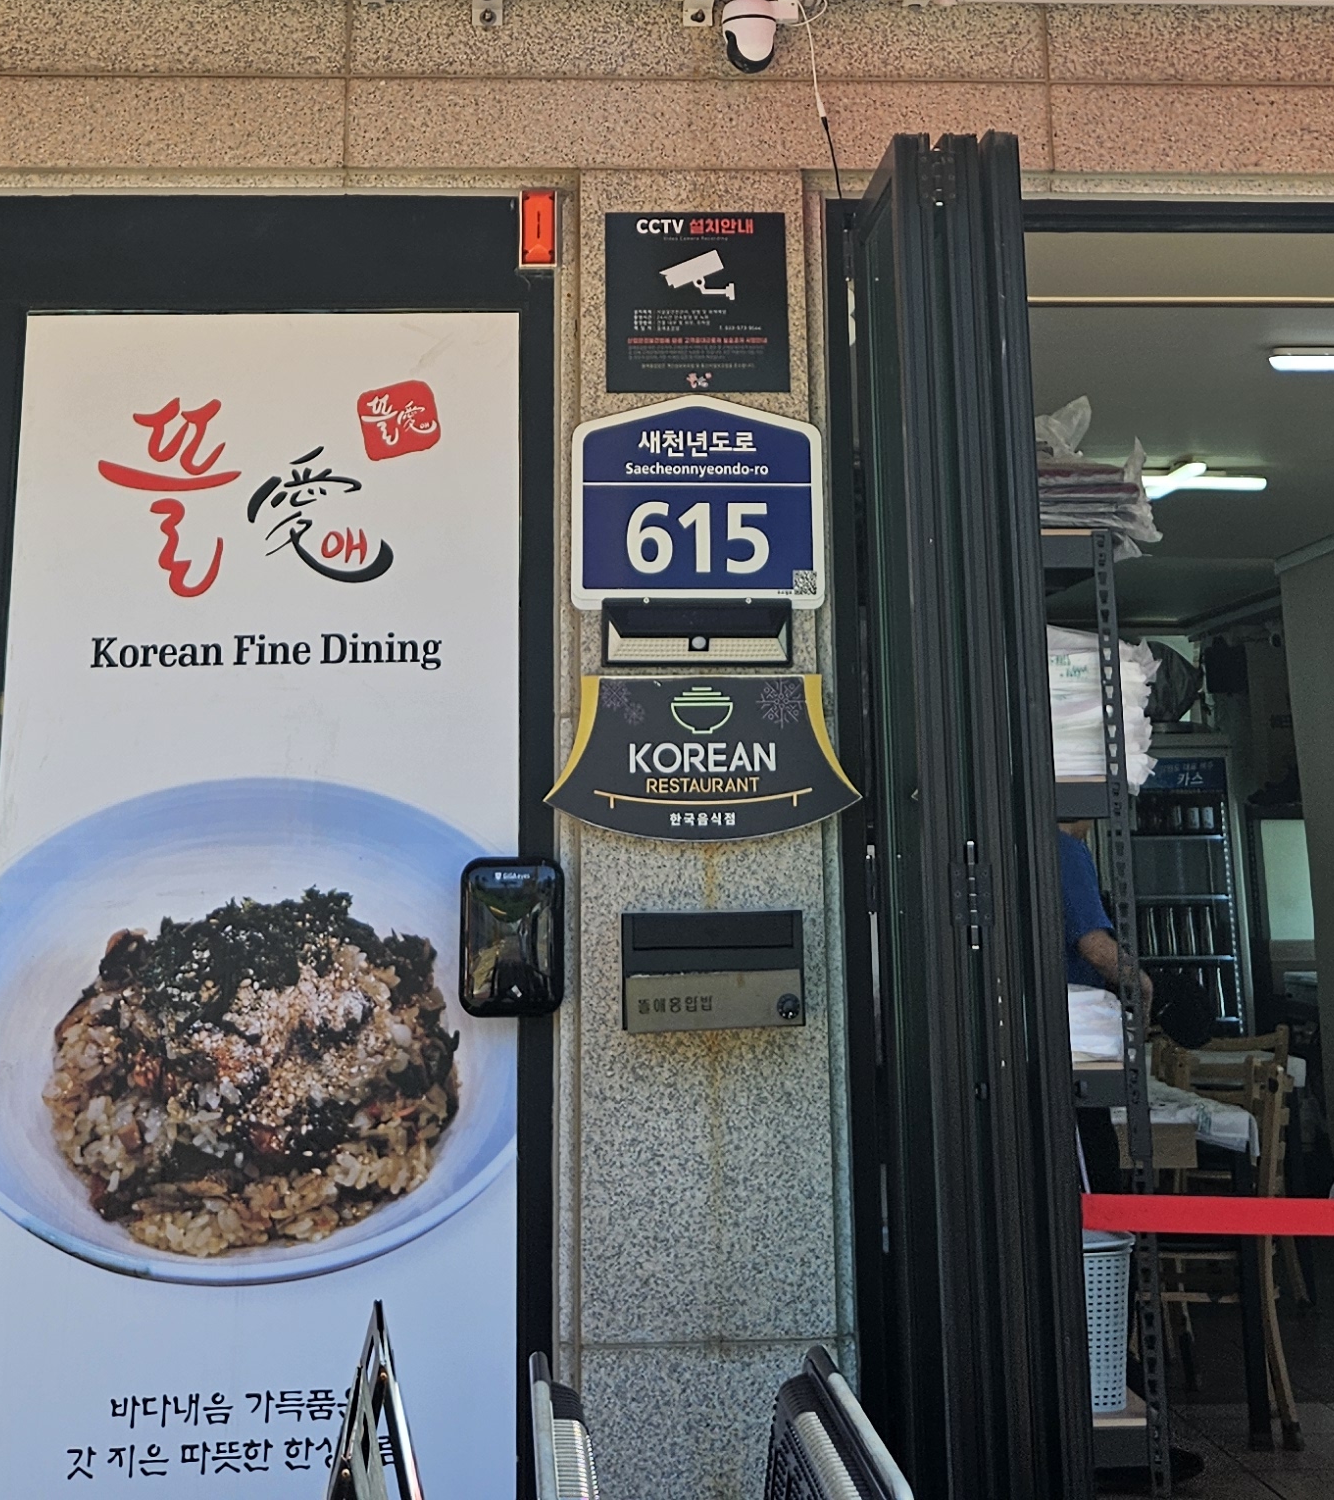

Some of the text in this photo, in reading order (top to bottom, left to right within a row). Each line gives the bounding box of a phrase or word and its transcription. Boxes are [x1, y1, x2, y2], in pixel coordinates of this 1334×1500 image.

[636, 218, 754, 235] CCTV 설치안내
[638, 430, 757, 457] 새천년도로
[625, 462, 769, 479] Saecheonnyeondo-ro
[625, 501, 770, 575] 615
[90, 631, 443, 671] Korean Fine Dining
[628, 742, 777, 774] KOREAN
[645, 777, 760, 794] RESTAURANT
[1177, 771, 1204, 787] 카스
[669, 812, 737, 827] 한국음식점
[111, 1392, 234, 1430] 바다내음
[66, 1446, 97, 1481] 갓
[107, 1442, 170, 1477] 지은
[180, 1437, 273, 1475] 따뜻한
